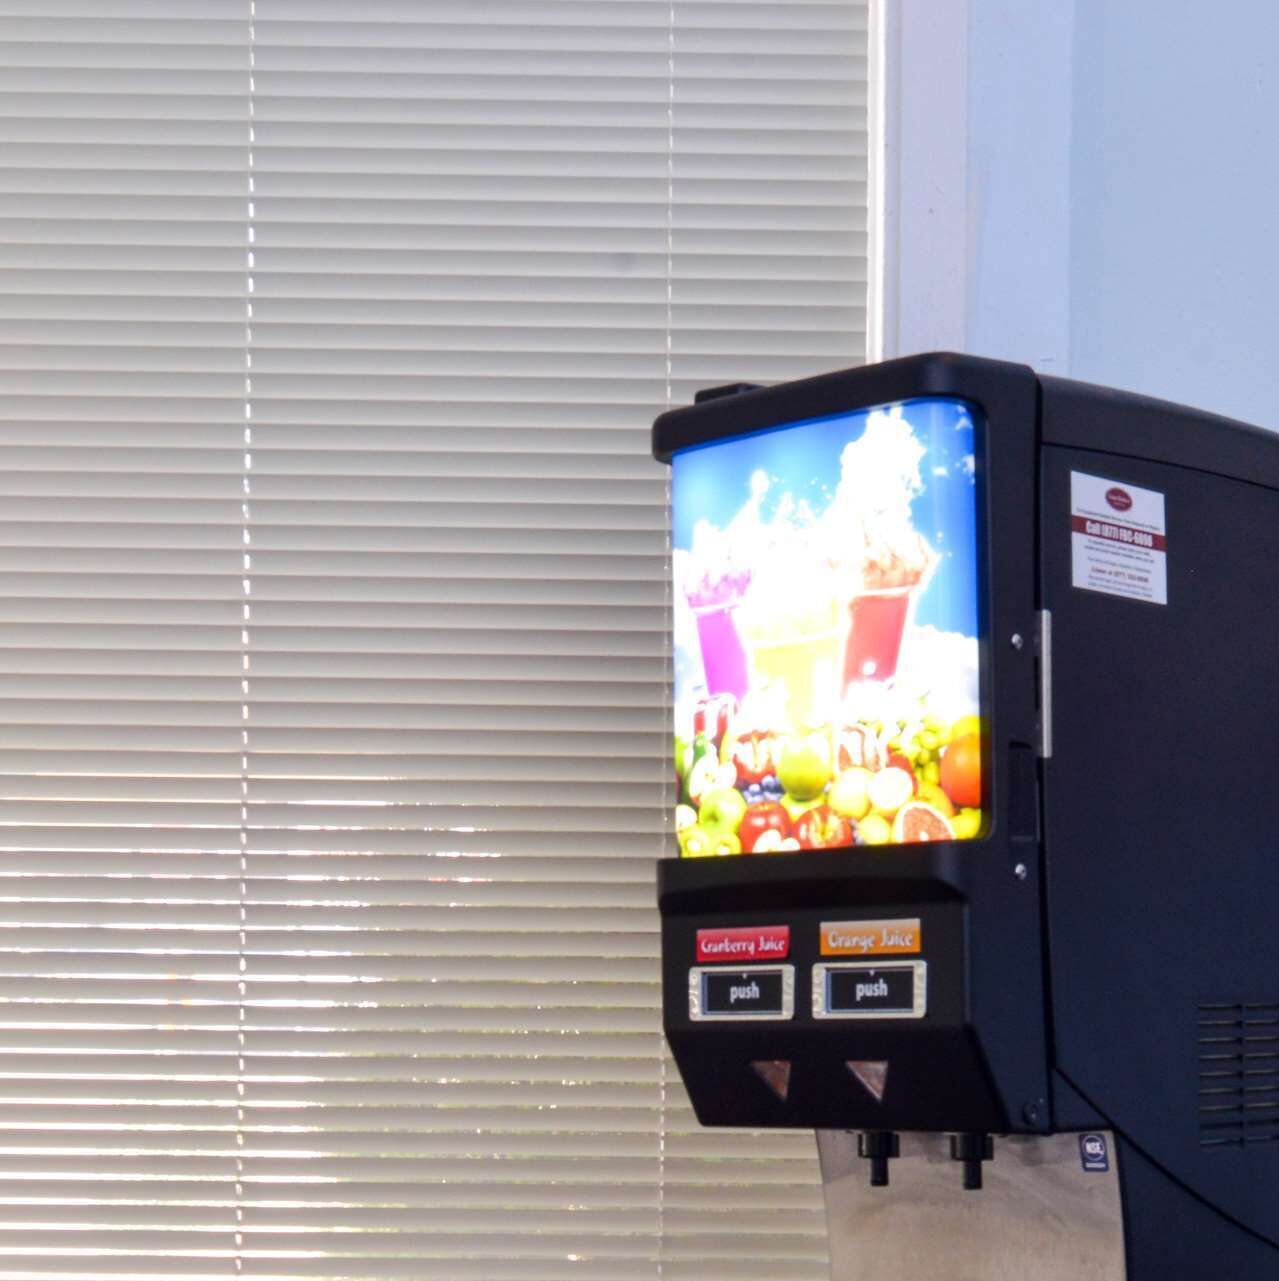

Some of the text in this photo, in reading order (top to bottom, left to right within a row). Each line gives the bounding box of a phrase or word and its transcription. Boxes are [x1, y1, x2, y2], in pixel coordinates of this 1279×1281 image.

[700, 936, 785, 955] Cranberry Juice
[828, 928, 914, 952] Orange Juice
[730, 981, 760, 1003] push
[855, 978, 888, 1001] push
